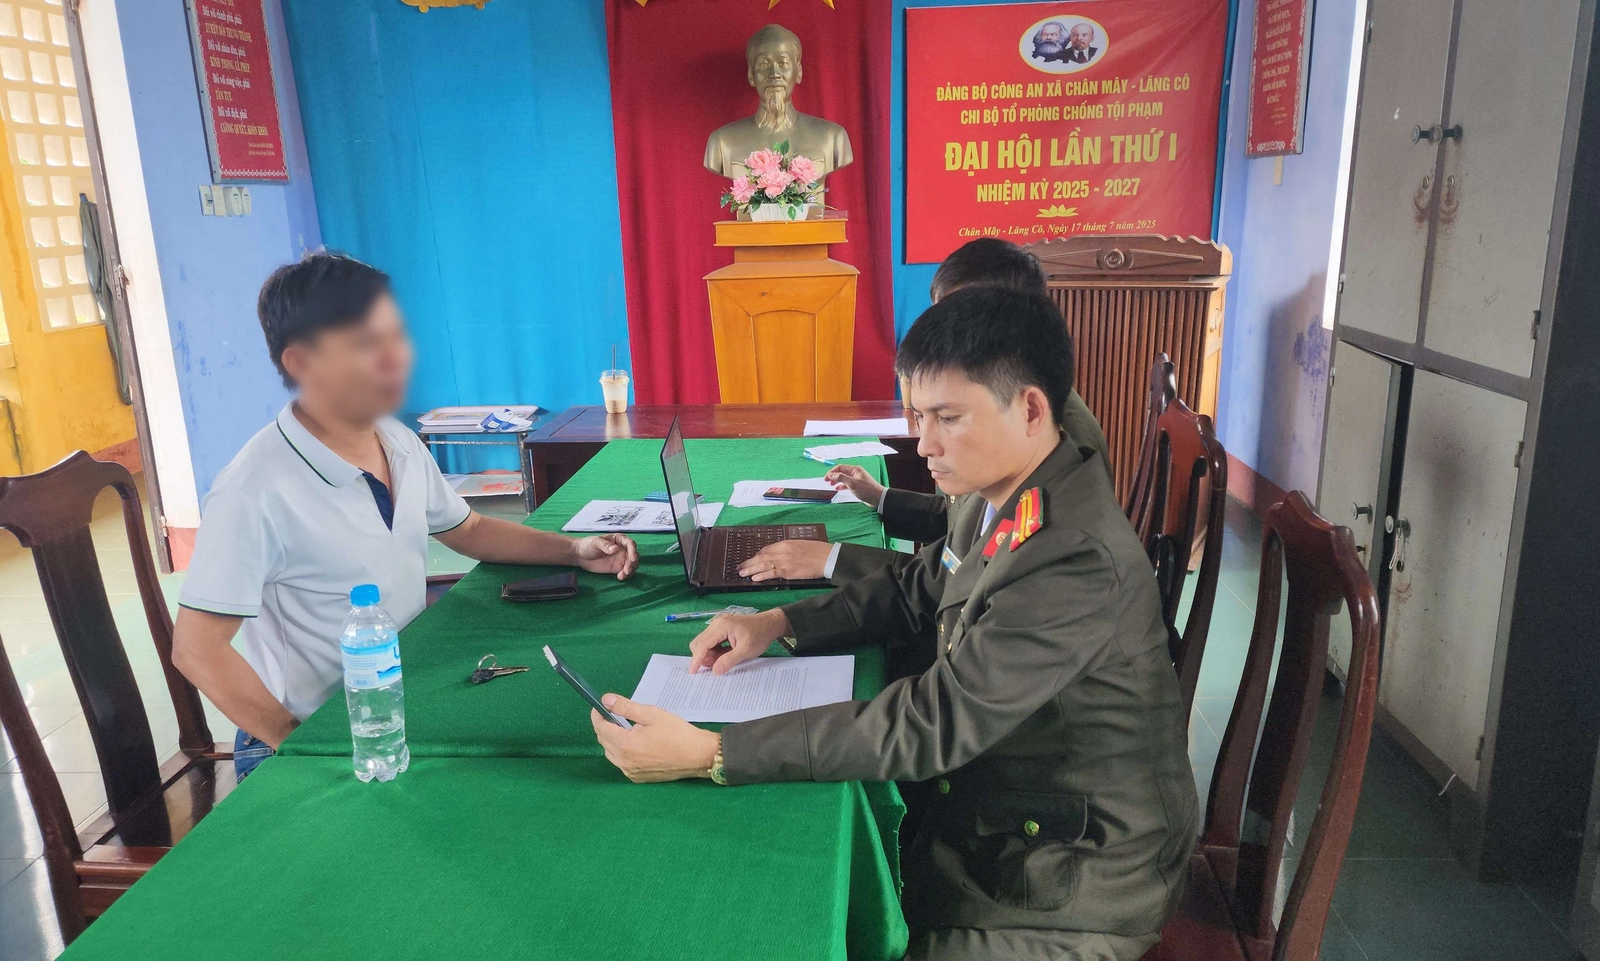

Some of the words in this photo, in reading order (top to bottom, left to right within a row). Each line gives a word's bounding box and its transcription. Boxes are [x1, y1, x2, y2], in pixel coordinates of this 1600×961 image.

[936, 82, 969, 102] ĐẢNG
[972, 82, 988, 103] BỘ
[991, 82, 1023, 99] CÔNG
[1026, 83, 1043, 98] AN
[1046, 79, 1062, 97] XÃ
[1065, 78, 1098, 96] CHÂN
[1101, 77, 1128, 94] MÂY
[1139, 75, 1171, 93] LĂNG
[1173, 73, 1191, 91] CÔ
[961, 109, 980, 125] CHI
[983, 106, 999, 126] BỘ
[1002, 102, 1017, 123] TỔ
[1020, 104, 1060, 122] PHÒNG
[1063, 100, 1103, 120] CHỐNG
[1107, 101, 1125, 121] TỘI
[1128, 102, 1163, 120] PHẠM
[945, 141, 989, 177] ĐẠI
[998, 133, 1041, 174] HỘI
[1050, 127, 1101, 168] LẦN
[1110, 127, 1164, 164] THỨ
[1168, 132, 1178, 161] I
[977, 180, 1025, 205] NHIỆM
[1030, 178, 1049, 200] KỲ
[1053, 180, 1090, 199] 2025
[1103, 178, 1141, 197] 2027
[959, 227, 980, 237] Chân
[982, 226, 1001, 238] Mây
[1008, 225, 1029, 237] Lăng
[1031, 224, 1045, 235] Cô,
[1048, 224, 1068, 236] Ngày
[1071, 222, 1081, 232] 17
[1082, 221, 1107, 234] tháng
[1109, 221, 1115, 230] 7
[1116, 221, 1134, 230] năm
[1136, 219, 1157, 229] 2025
